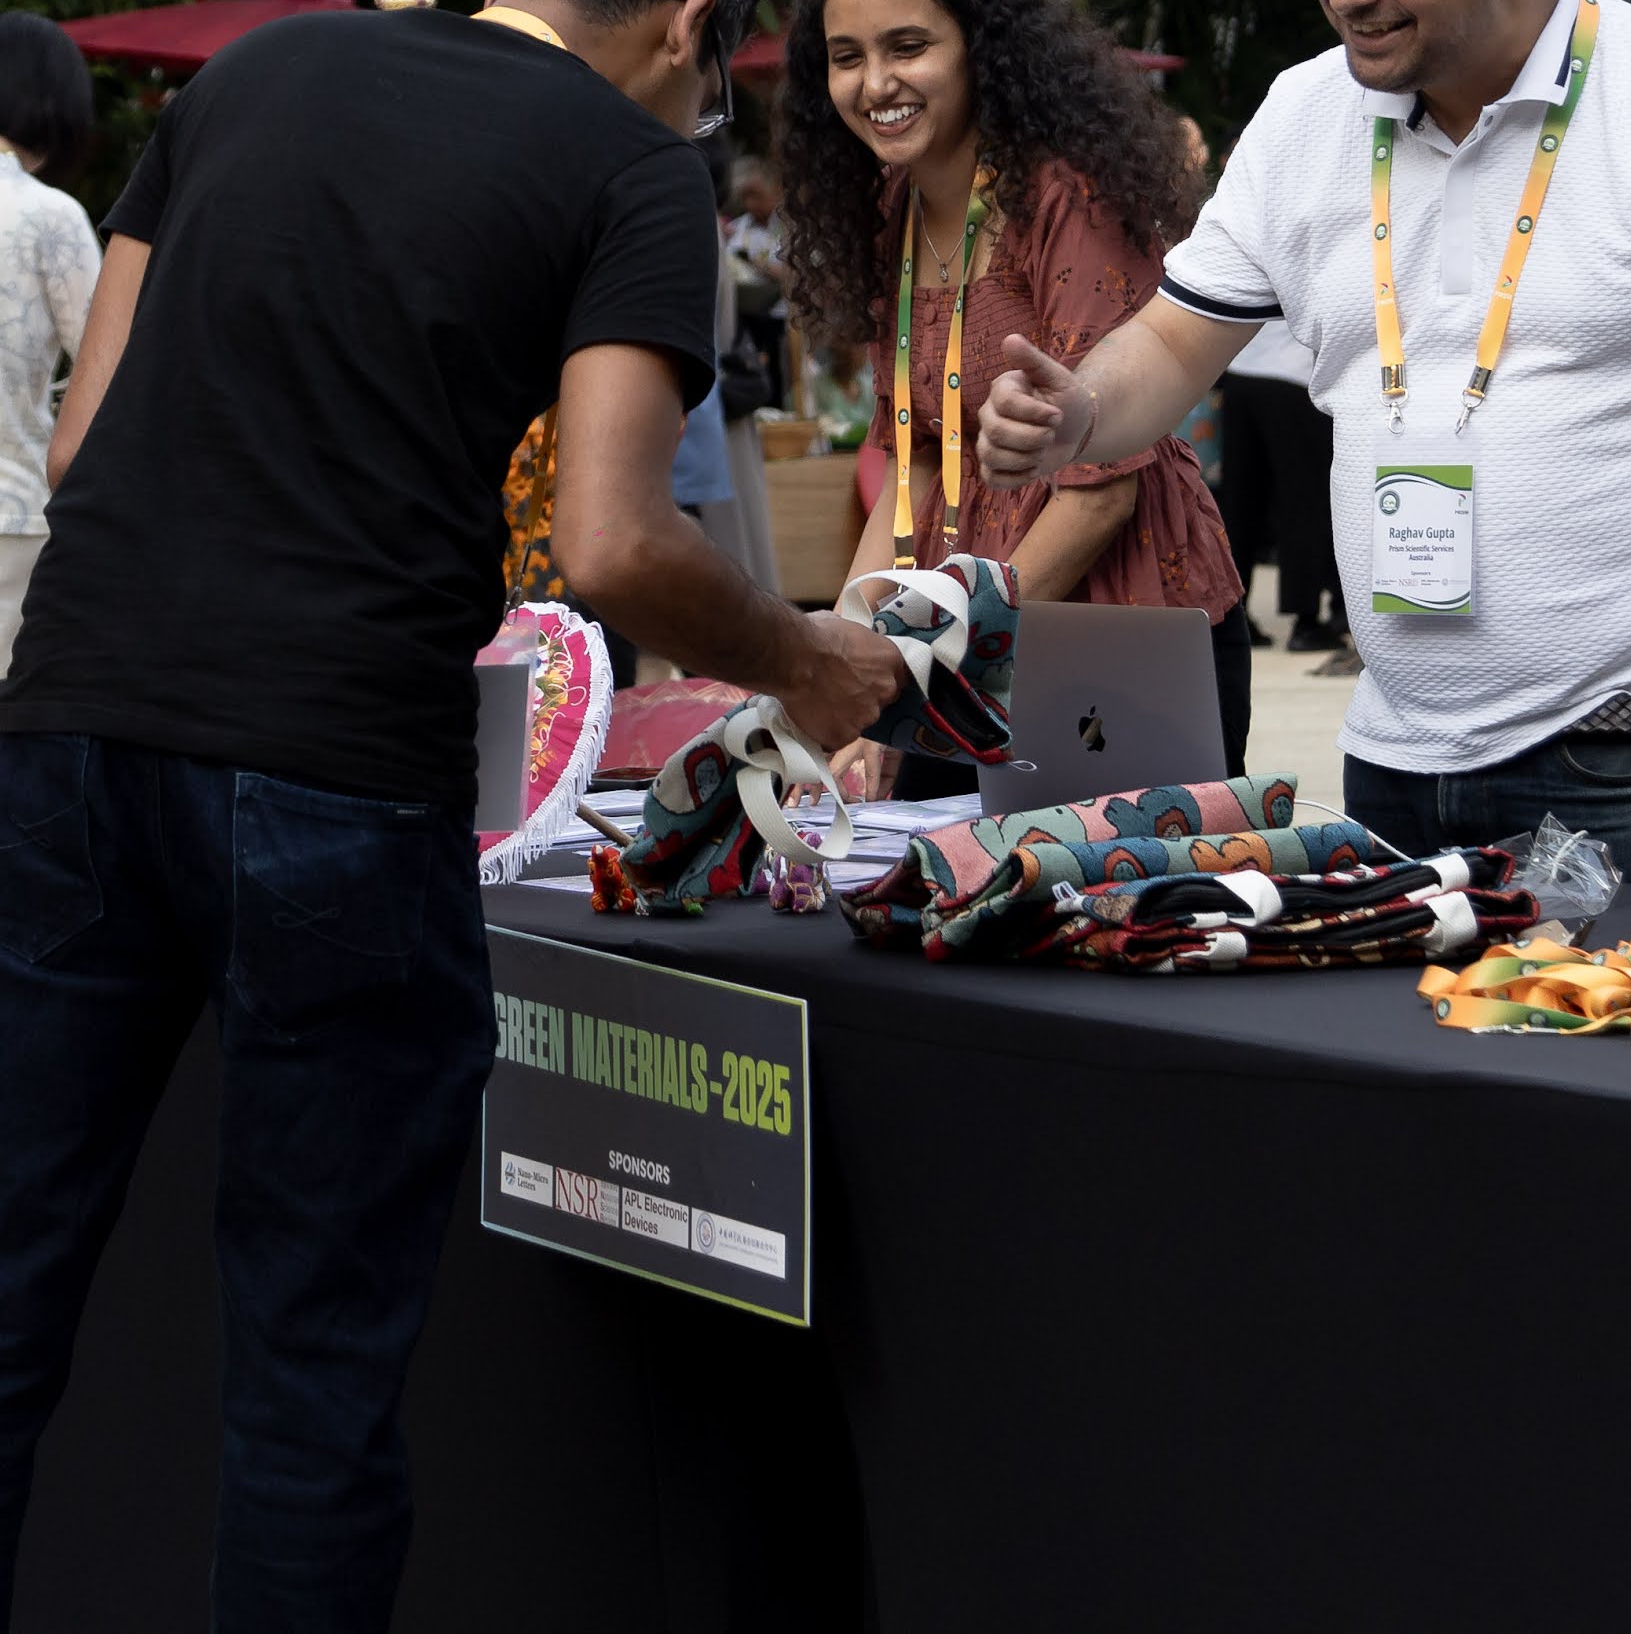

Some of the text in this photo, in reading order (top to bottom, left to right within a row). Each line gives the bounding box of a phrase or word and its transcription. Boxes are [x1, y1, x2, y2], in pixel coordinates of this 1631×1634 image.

[1389, 526, 1455, 542] Raghav Gupta
[1431, 545, 1455, 553] Services
[572, 1011, 792, 1136] MATERIALS-2025
[608, 1150, 671, 1185] SPONSORS
[555, 1167, 600, 1221] NSR
[624, 1191, 642, 1210] APL
[644, 1196, 688, 1224] Electronic
[624, 1211, 658, 1235] Devices
